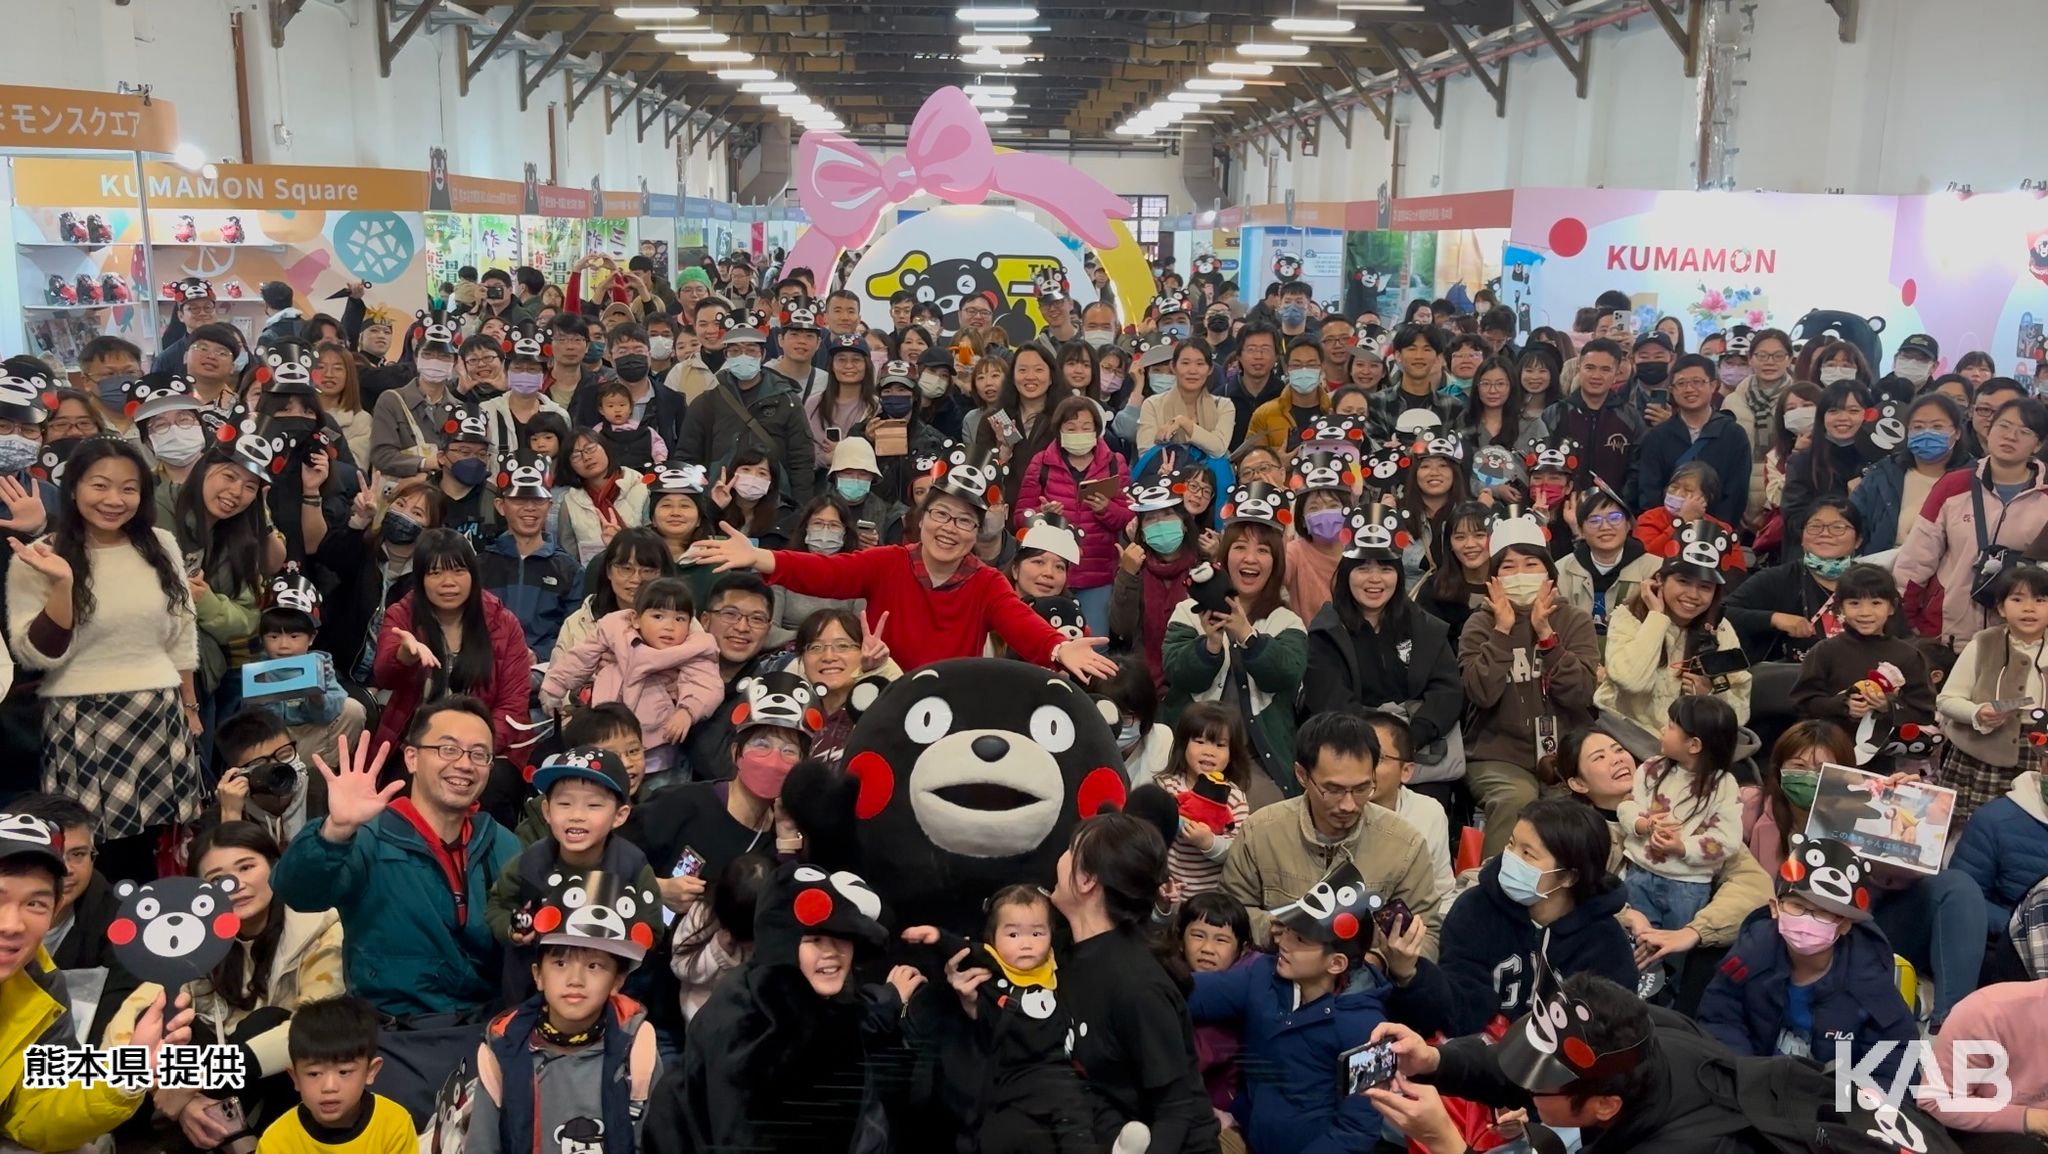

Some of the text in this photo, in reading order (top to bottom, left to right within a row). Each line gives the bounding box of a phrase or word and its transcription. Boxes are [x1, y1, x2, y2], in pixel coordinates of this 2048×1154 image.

[0, 104, 140, 138] モンスクエア
[101, 174, 359, 205] KUMAMON Square
[1607, 245, 1776, 273] KUMAMON
[1825, 1031, 1854, 1040] FILA
